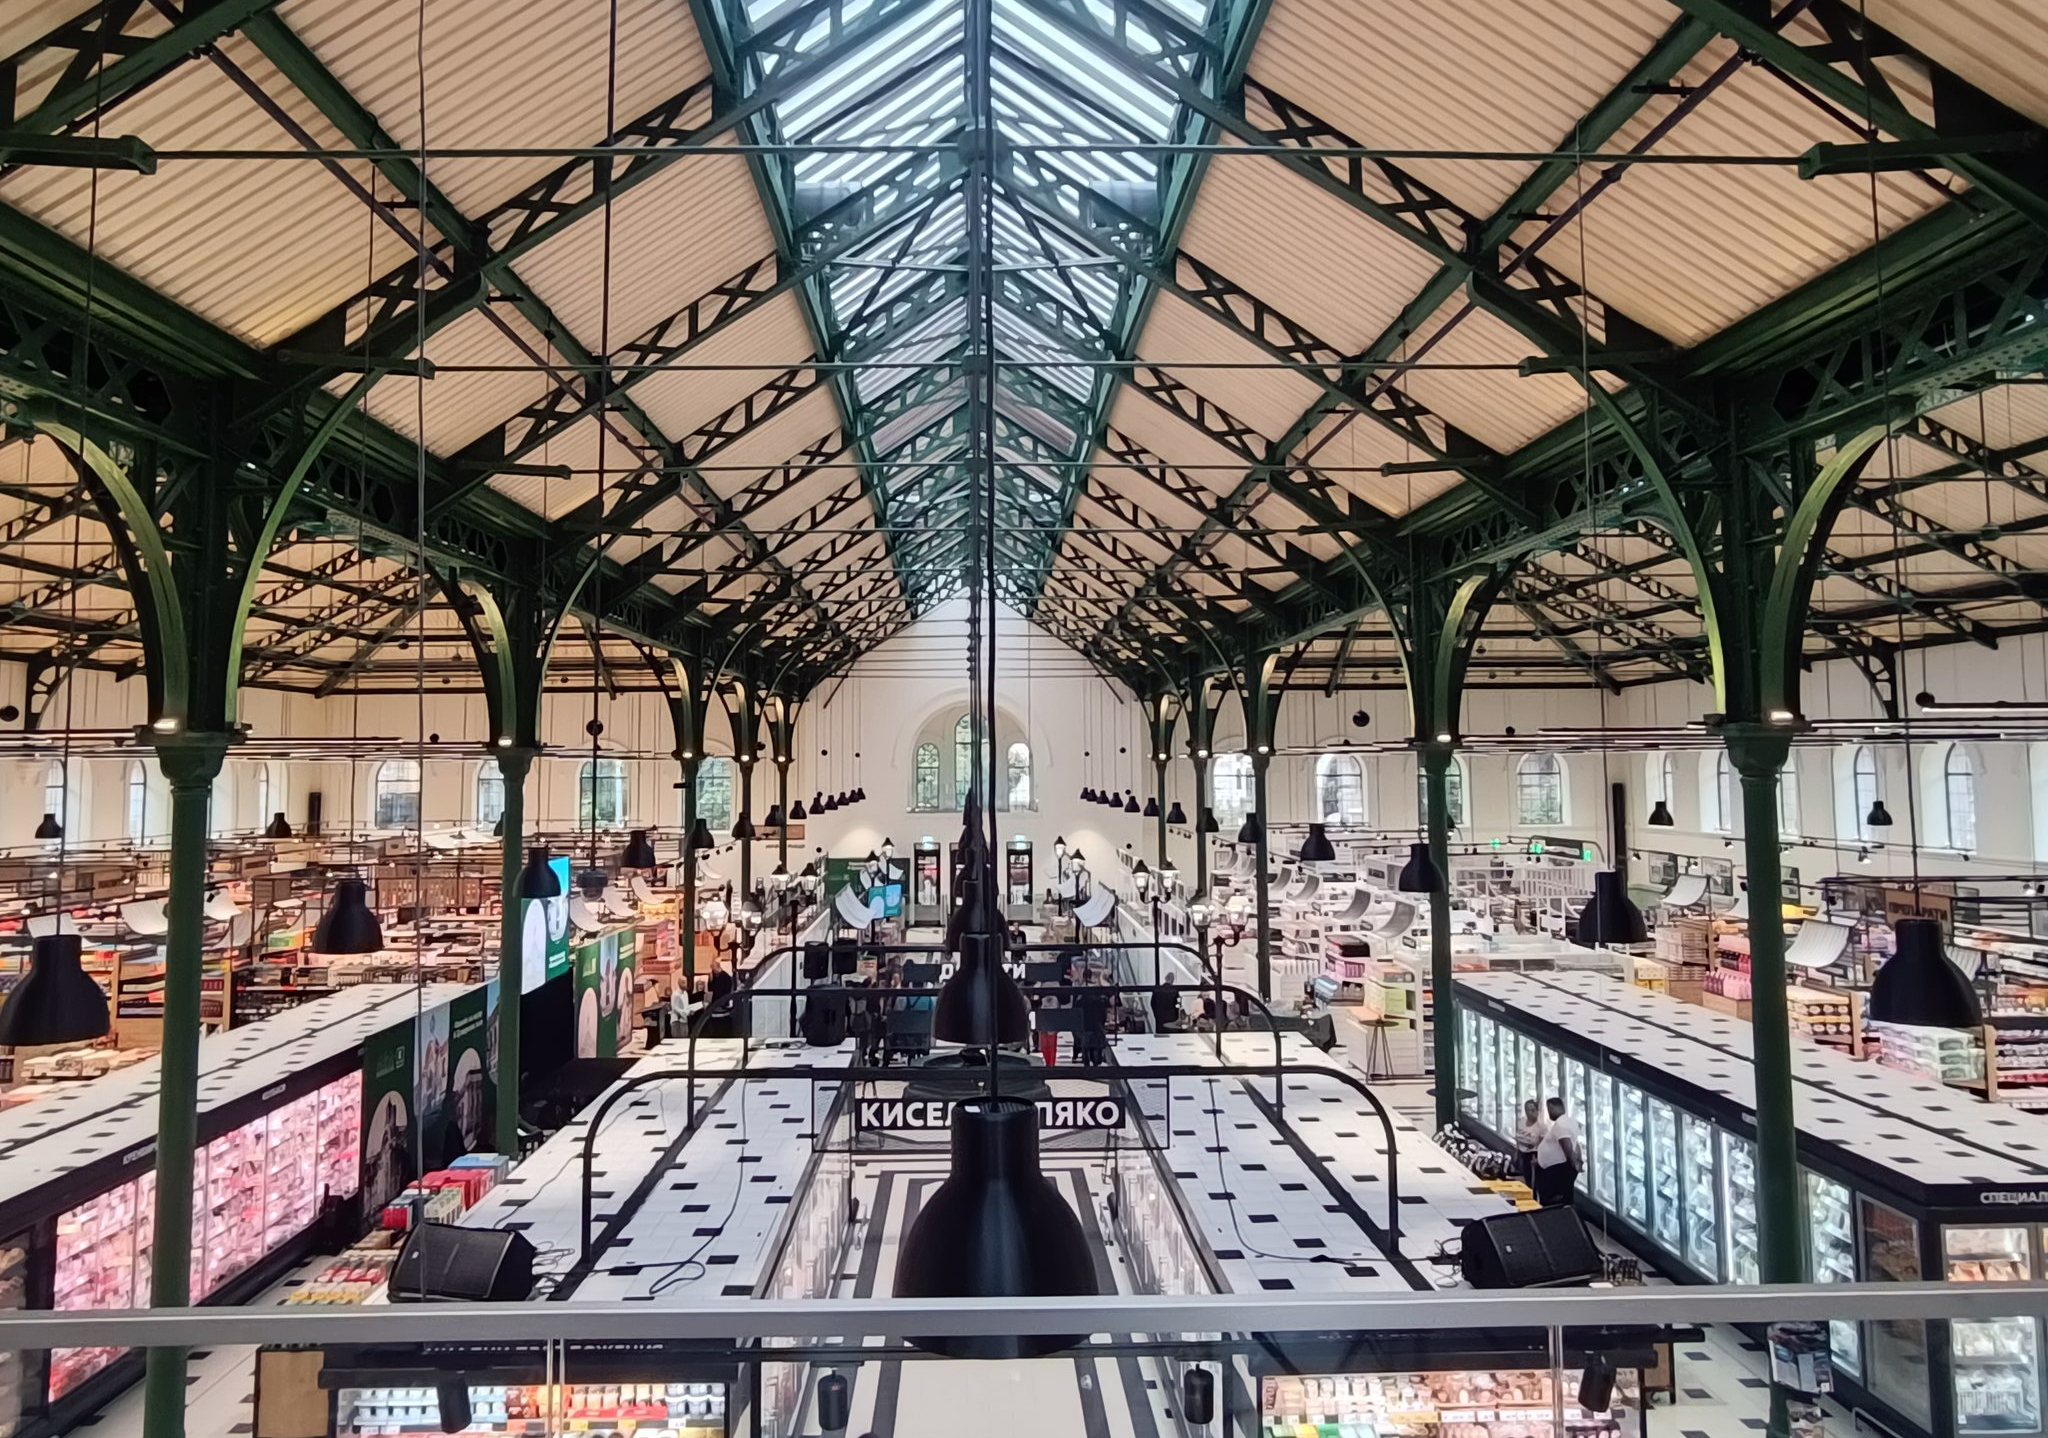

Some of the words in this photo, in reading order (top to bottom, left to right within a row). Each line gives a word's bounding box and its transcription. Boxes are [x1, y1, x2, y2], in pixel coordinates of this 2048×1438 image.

[861, 1101, 956, 1127] КИСЕ
[1035, 1101, 1119, 1126] ЛЯКО
[1980, 1191, 2048, 1205] СПЕЦИАЛ
